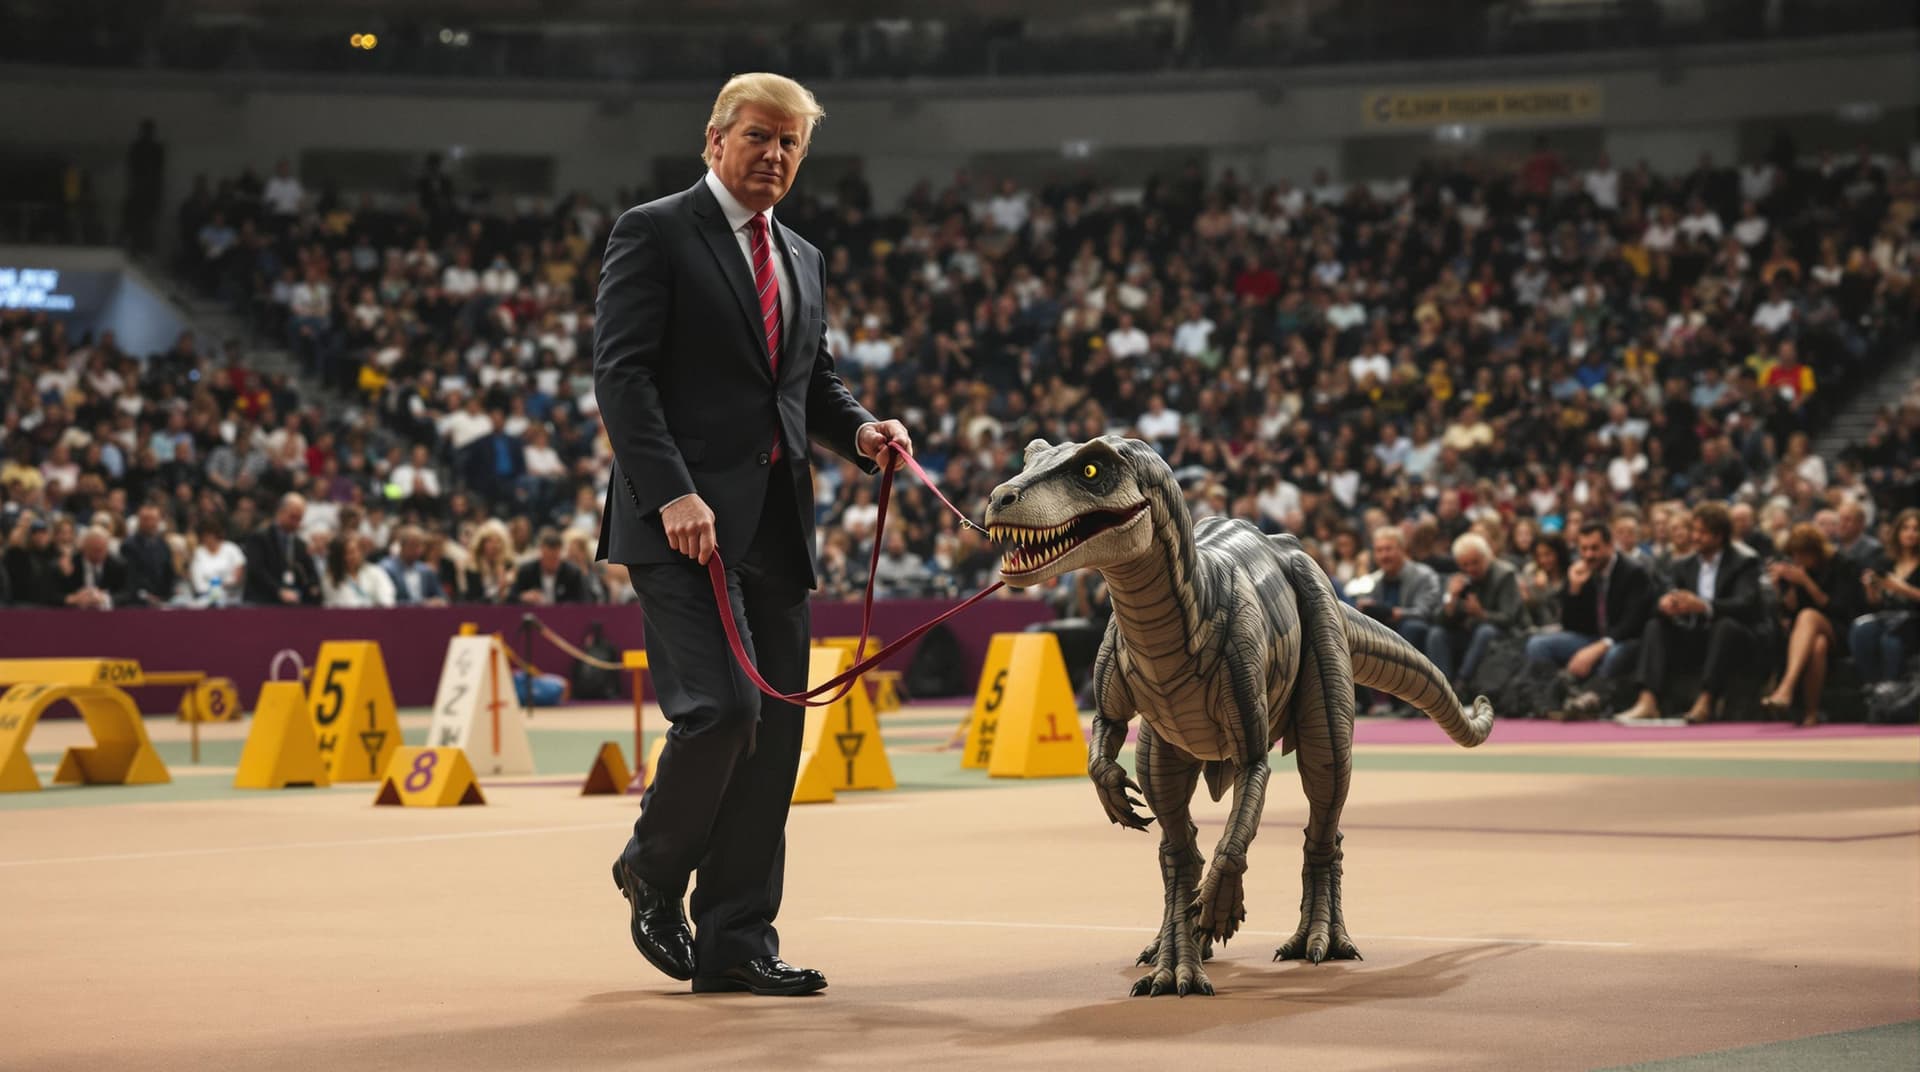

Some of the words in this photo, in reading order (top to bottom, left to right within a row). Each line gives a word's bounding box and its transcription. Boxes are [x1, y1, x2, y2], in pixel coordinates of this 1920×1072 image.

[316, 660, 350, 726] 5
[985, 669, 1008, 713] 5
[404, 751, 438, 793] 8
